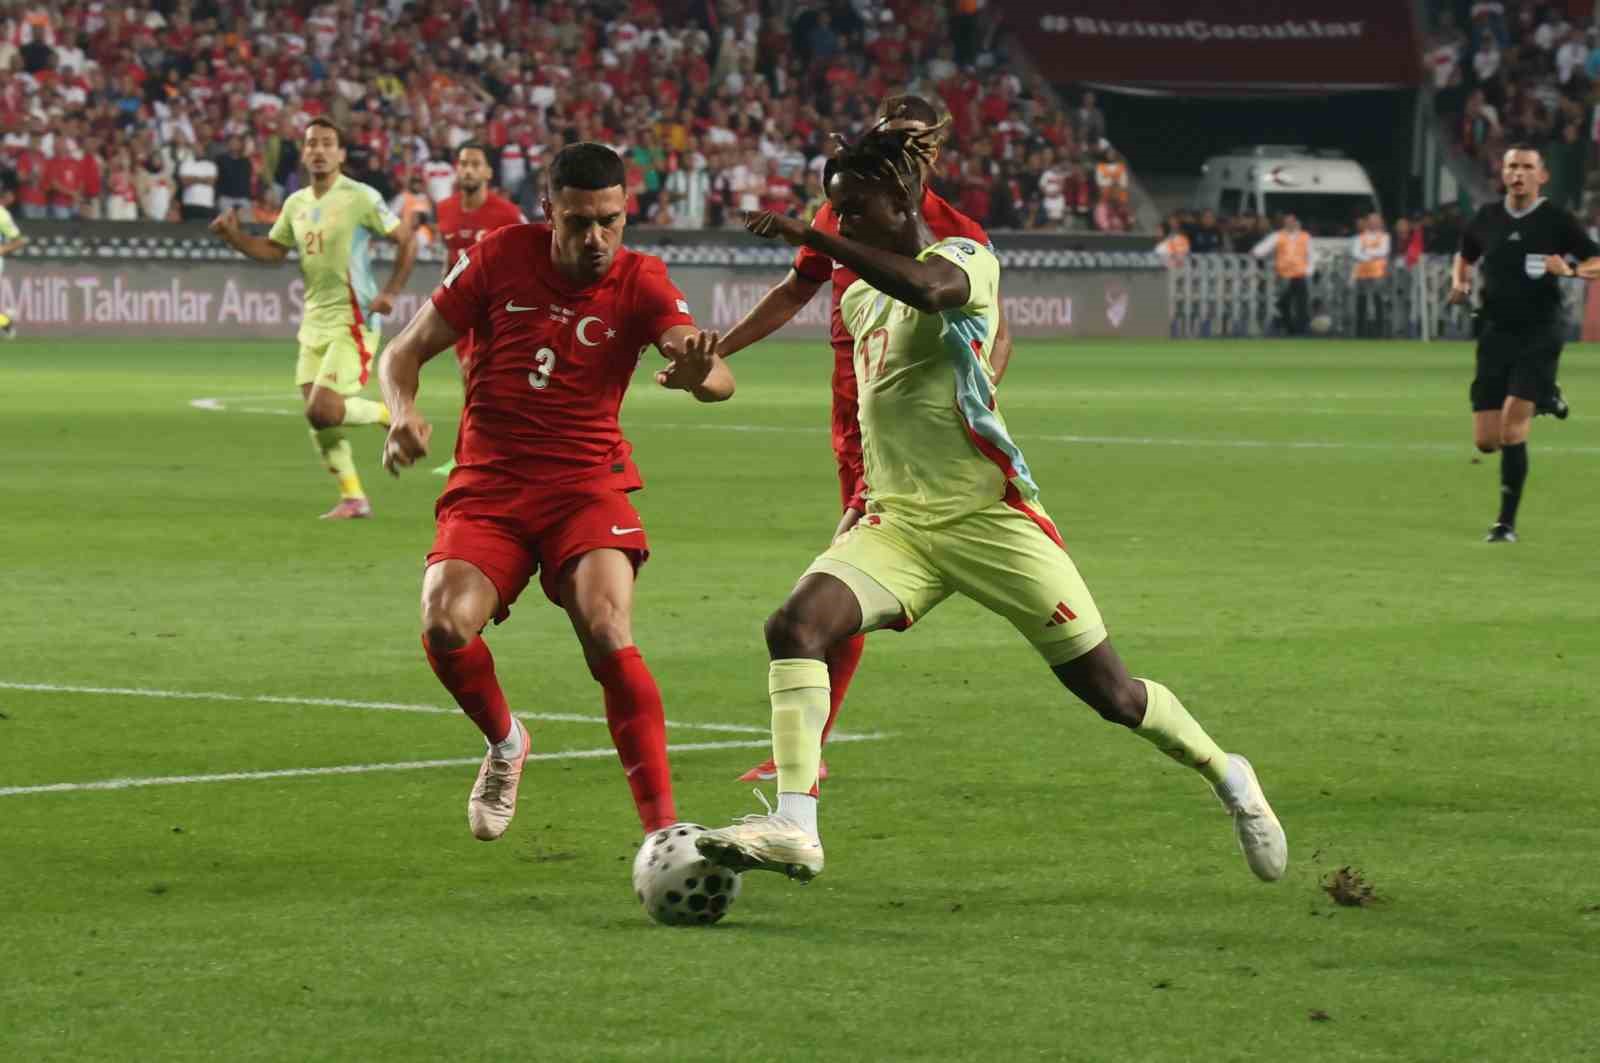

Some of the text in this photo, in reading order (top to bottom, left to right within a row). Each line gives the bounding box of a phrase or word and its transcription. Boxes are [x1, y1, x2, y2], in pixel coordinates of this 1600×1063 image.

[304, 231, 324, 255] 21
[75, 276, 212, 323] Takımlar
[217, 279, 282, 324] Ana
[1003, 296, 1073, 325] nsoru
[528, 347, 556, 389] 3
[860, 327, 889, 384] 17
